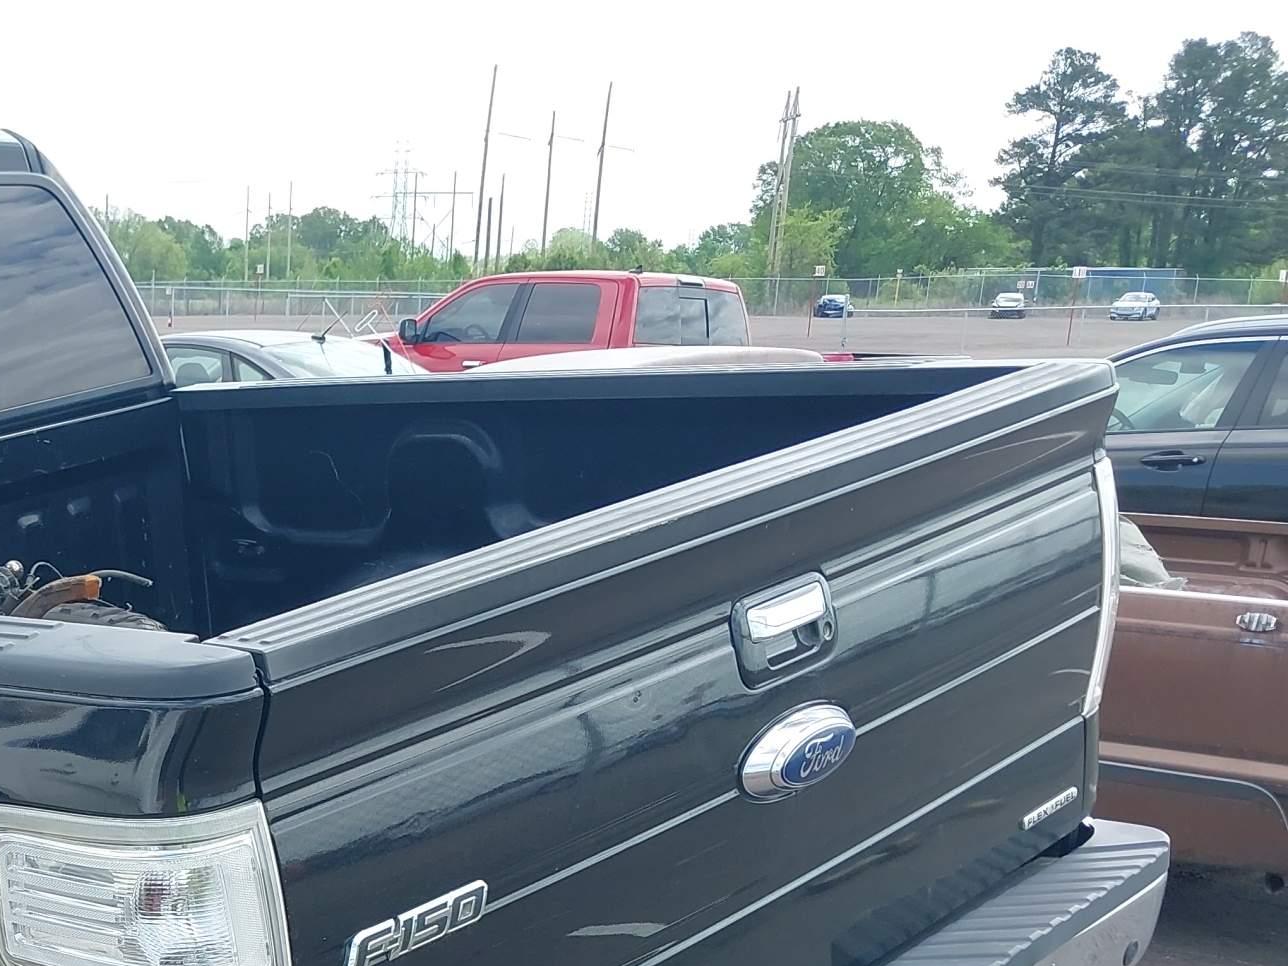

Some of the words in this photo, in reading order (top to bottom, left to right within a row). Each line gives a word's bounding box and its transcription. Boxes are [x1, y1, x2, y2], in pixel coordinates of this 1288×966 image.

[800, 732, 845, 778] Ford
[1027, 808, 1049, 828] FLEX
[1054, 791, 1076, 810] FUEL
